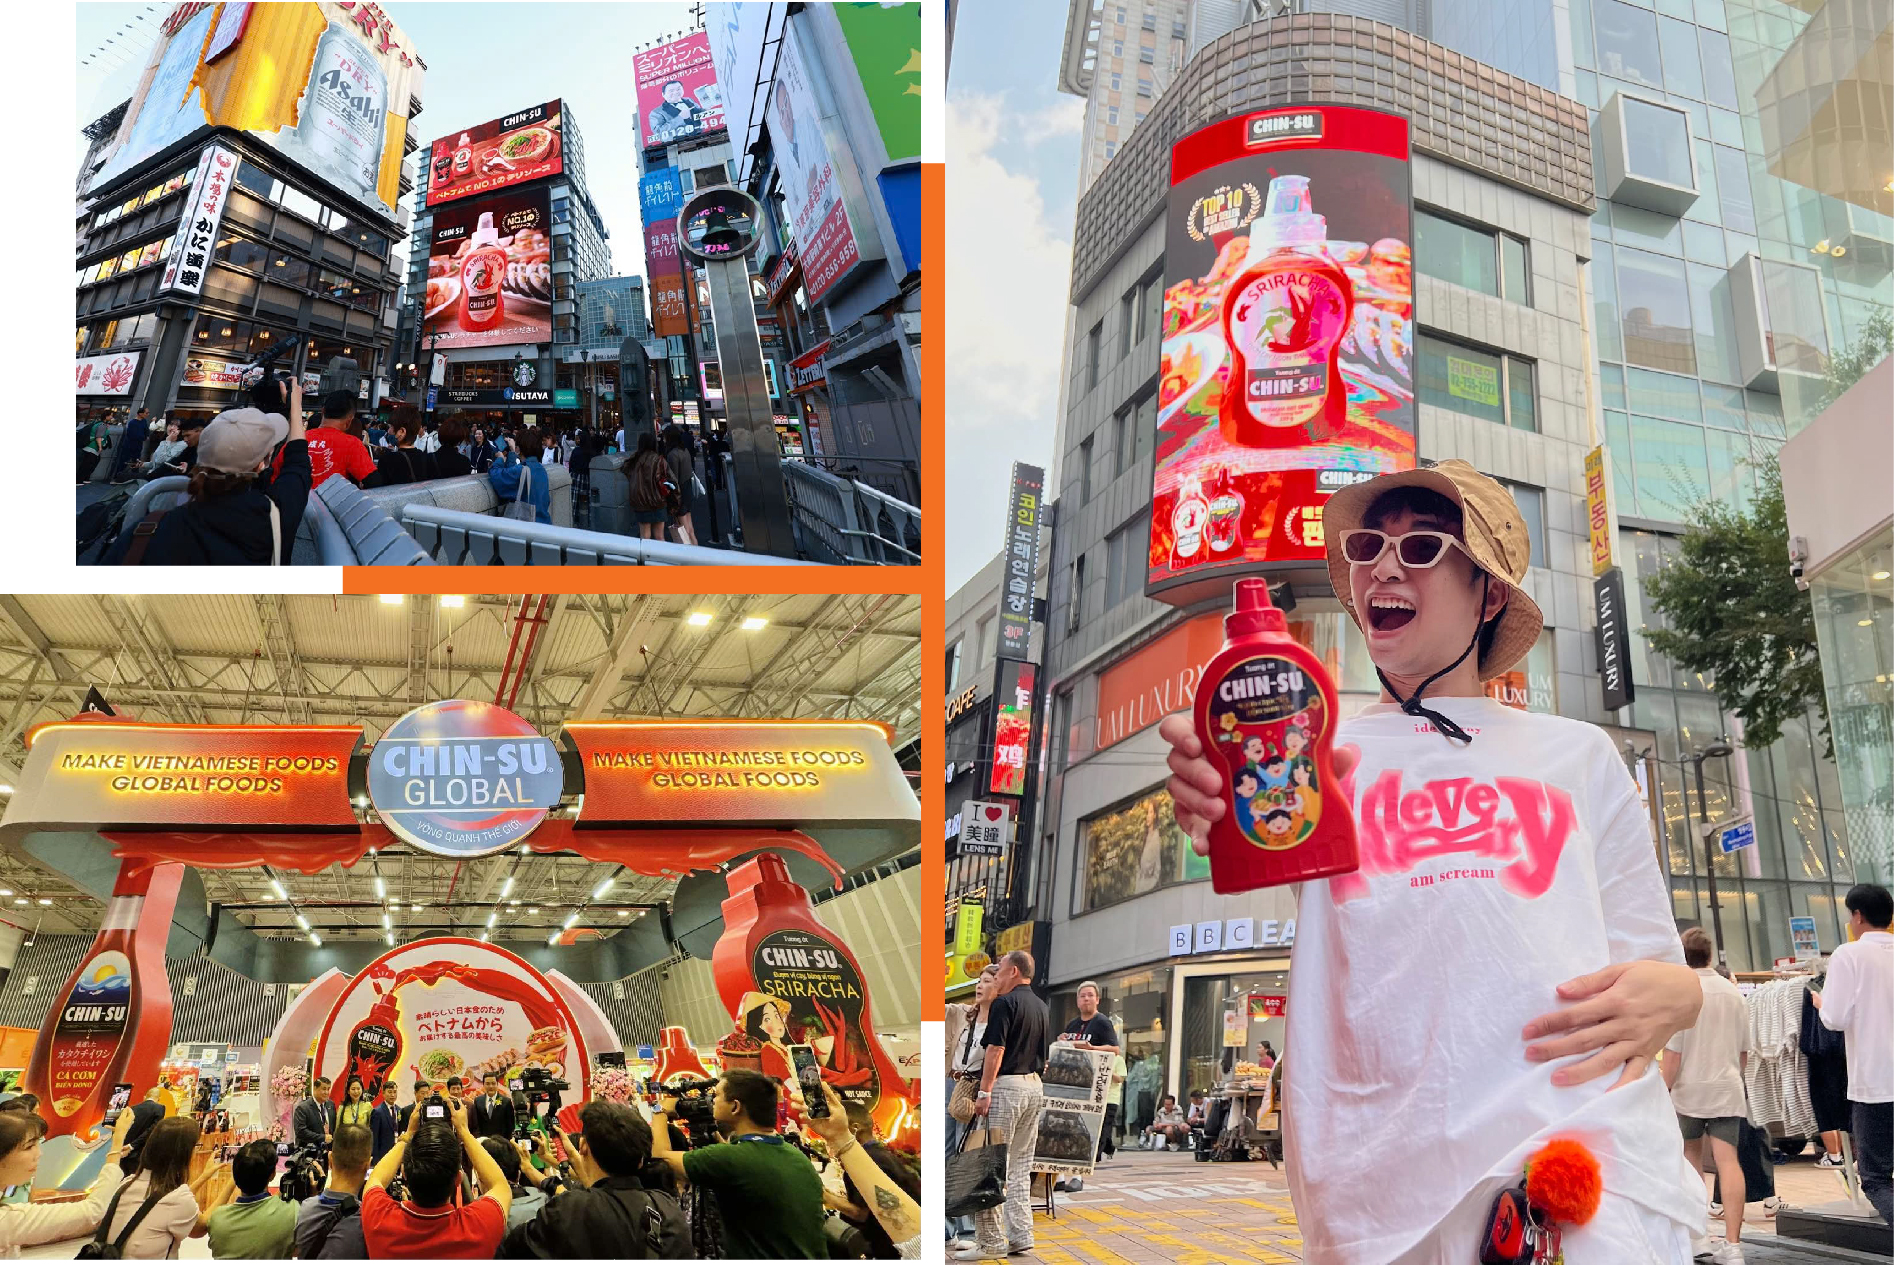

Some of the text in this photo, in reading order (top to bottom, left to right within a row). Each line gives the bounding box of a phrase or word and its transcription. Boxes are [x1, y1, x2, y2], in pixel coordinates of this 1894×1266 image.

[637, 42, 690, 65] スーパー
[319, 70, 380, 128] Asahi
[340, 107, 358, 127] 生
[503, 107, 542, 127] CHIN-SU
[1253, 114, 1314, 134] CHIN-SU
[1202, 188, 1243, 217] TOP 10
[438, 226, 464, 238] CHIN-SU
[180, 217, 214, 288] かに道楽
[1246, 272, 1331, 302] SRIRACHA
[469, 298, 496, 309] CHIN-SU
[1249, 375, 1322, 396] CHIN-SU
[1588, 469, 1609, 562] 부동산
[1004, 625, 1024, 640] 3F
[1599, 587, 1620, 692] UM LUXURY
[1219, 671, 1304, 703] CHIN-SU
[1528, 672, 1552, 691] UM
[946, 684, 978, 722] CAFE
[1494, 684, 1553, 709] LUXURY
[1097, 704, 1124, 749] UM
[61, 754, 338, 771] MAKE VIETNAMESE FOODS
[384, 743, 548, 777] CHIN-SU
[593, 751, 865, 767] MAKE VIETNAMESE FOODS
[111, 776, 283, 792] GLOBAL FOODS
[652, 771, 820, 787] GLOBAL FOODS
[404, 778, 534, 806] GLOBAL
[971, 804, 981, 822] I
[445, 832, 481, 843] QUANH
[965, 825, 1000, 843] 美瞳
[964, 844, 999, 854] LENS ME
[1410, 867, 1495, 888] am scream
[761, 947, 838, 969] CHIN-SU
[763, 980, 861, 999] SRIRACHA
[64, 1005, 126, 1022] CHIN-SU
[416, 1006, 504, 1021] 素晴らしい日本食のため
[418, 1016, 503, 1032] ベトナムから
[357, 1029, 395, 1048] CHIN-SU
[57, 1048, 111, 1059] カタクチイワシ
